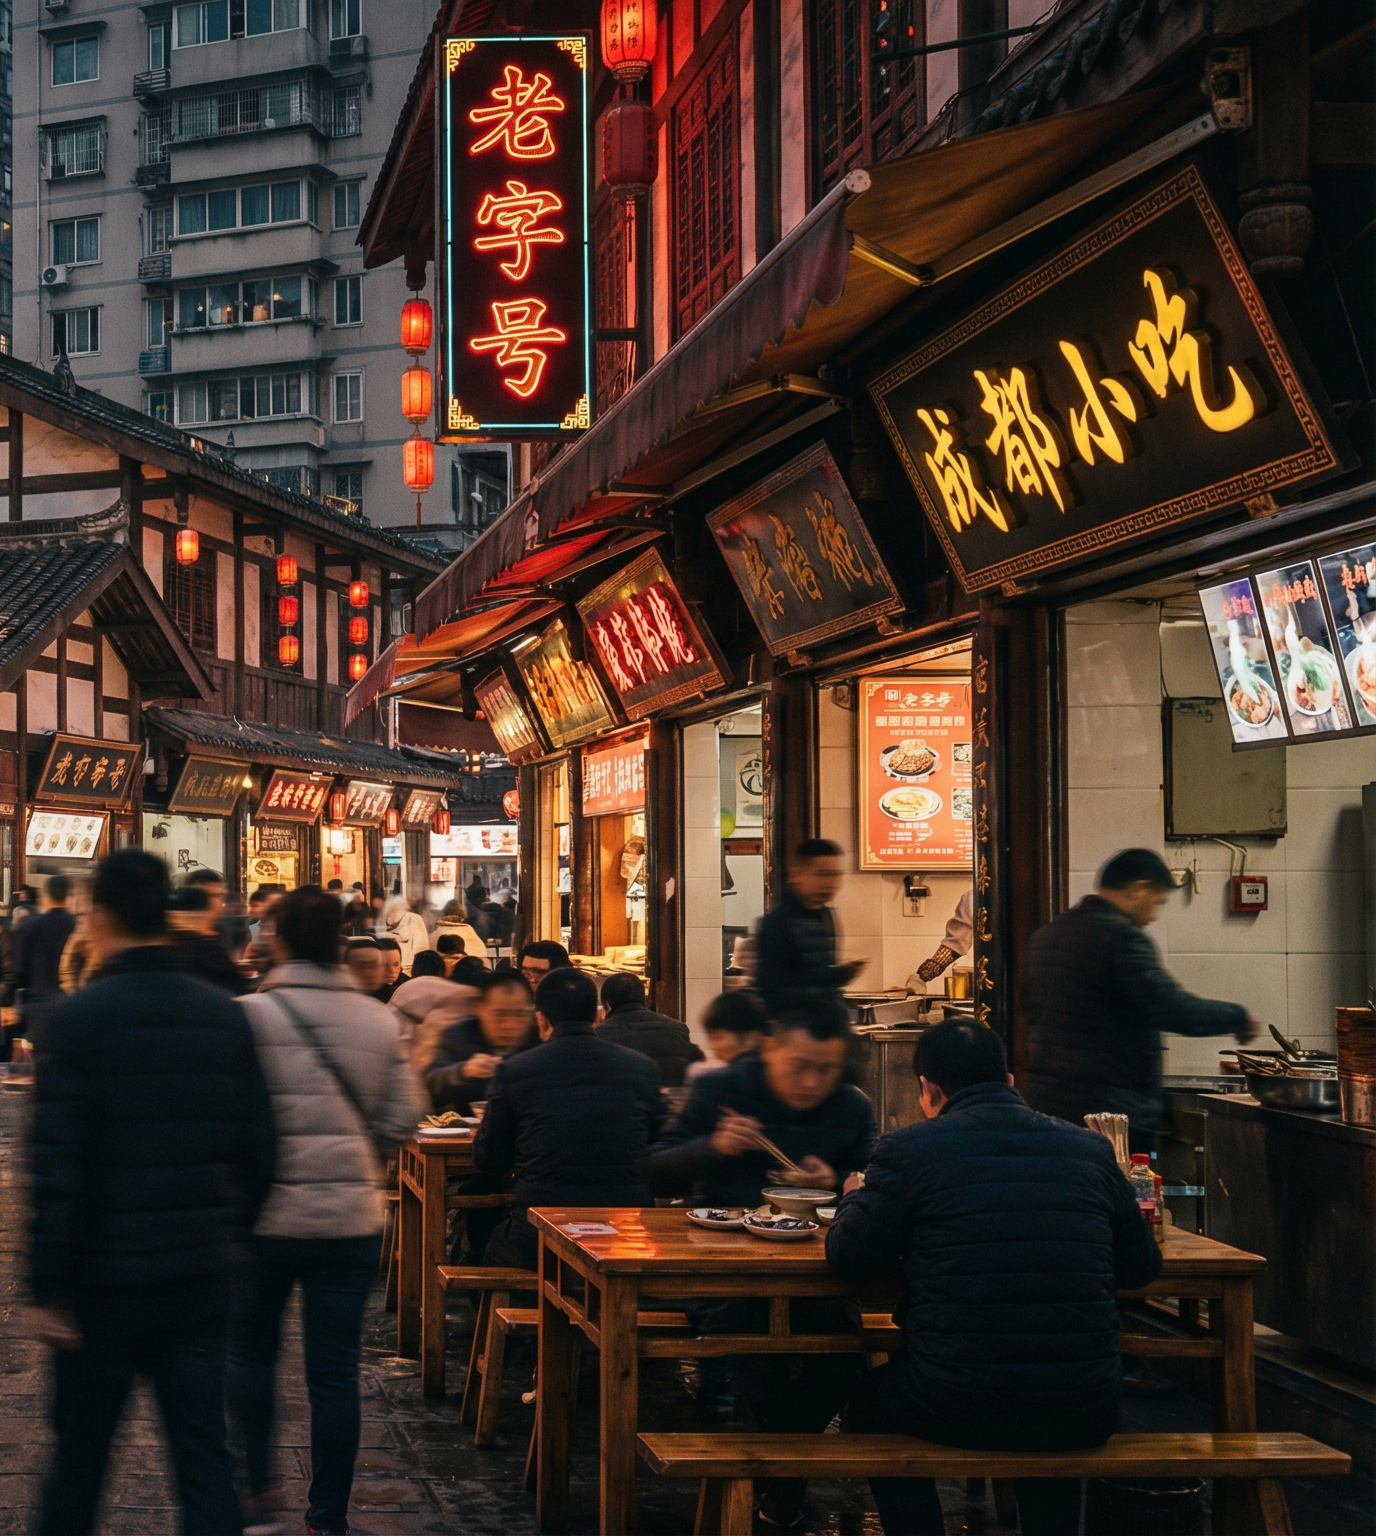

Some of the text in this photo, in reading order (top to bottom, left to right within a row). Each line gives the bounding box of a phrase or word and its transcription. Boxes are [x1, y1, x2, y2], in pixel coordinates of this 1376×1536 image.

[469, 65, 566, 397] 老字号
[916, 269, 1255, 532] 成都小吃
